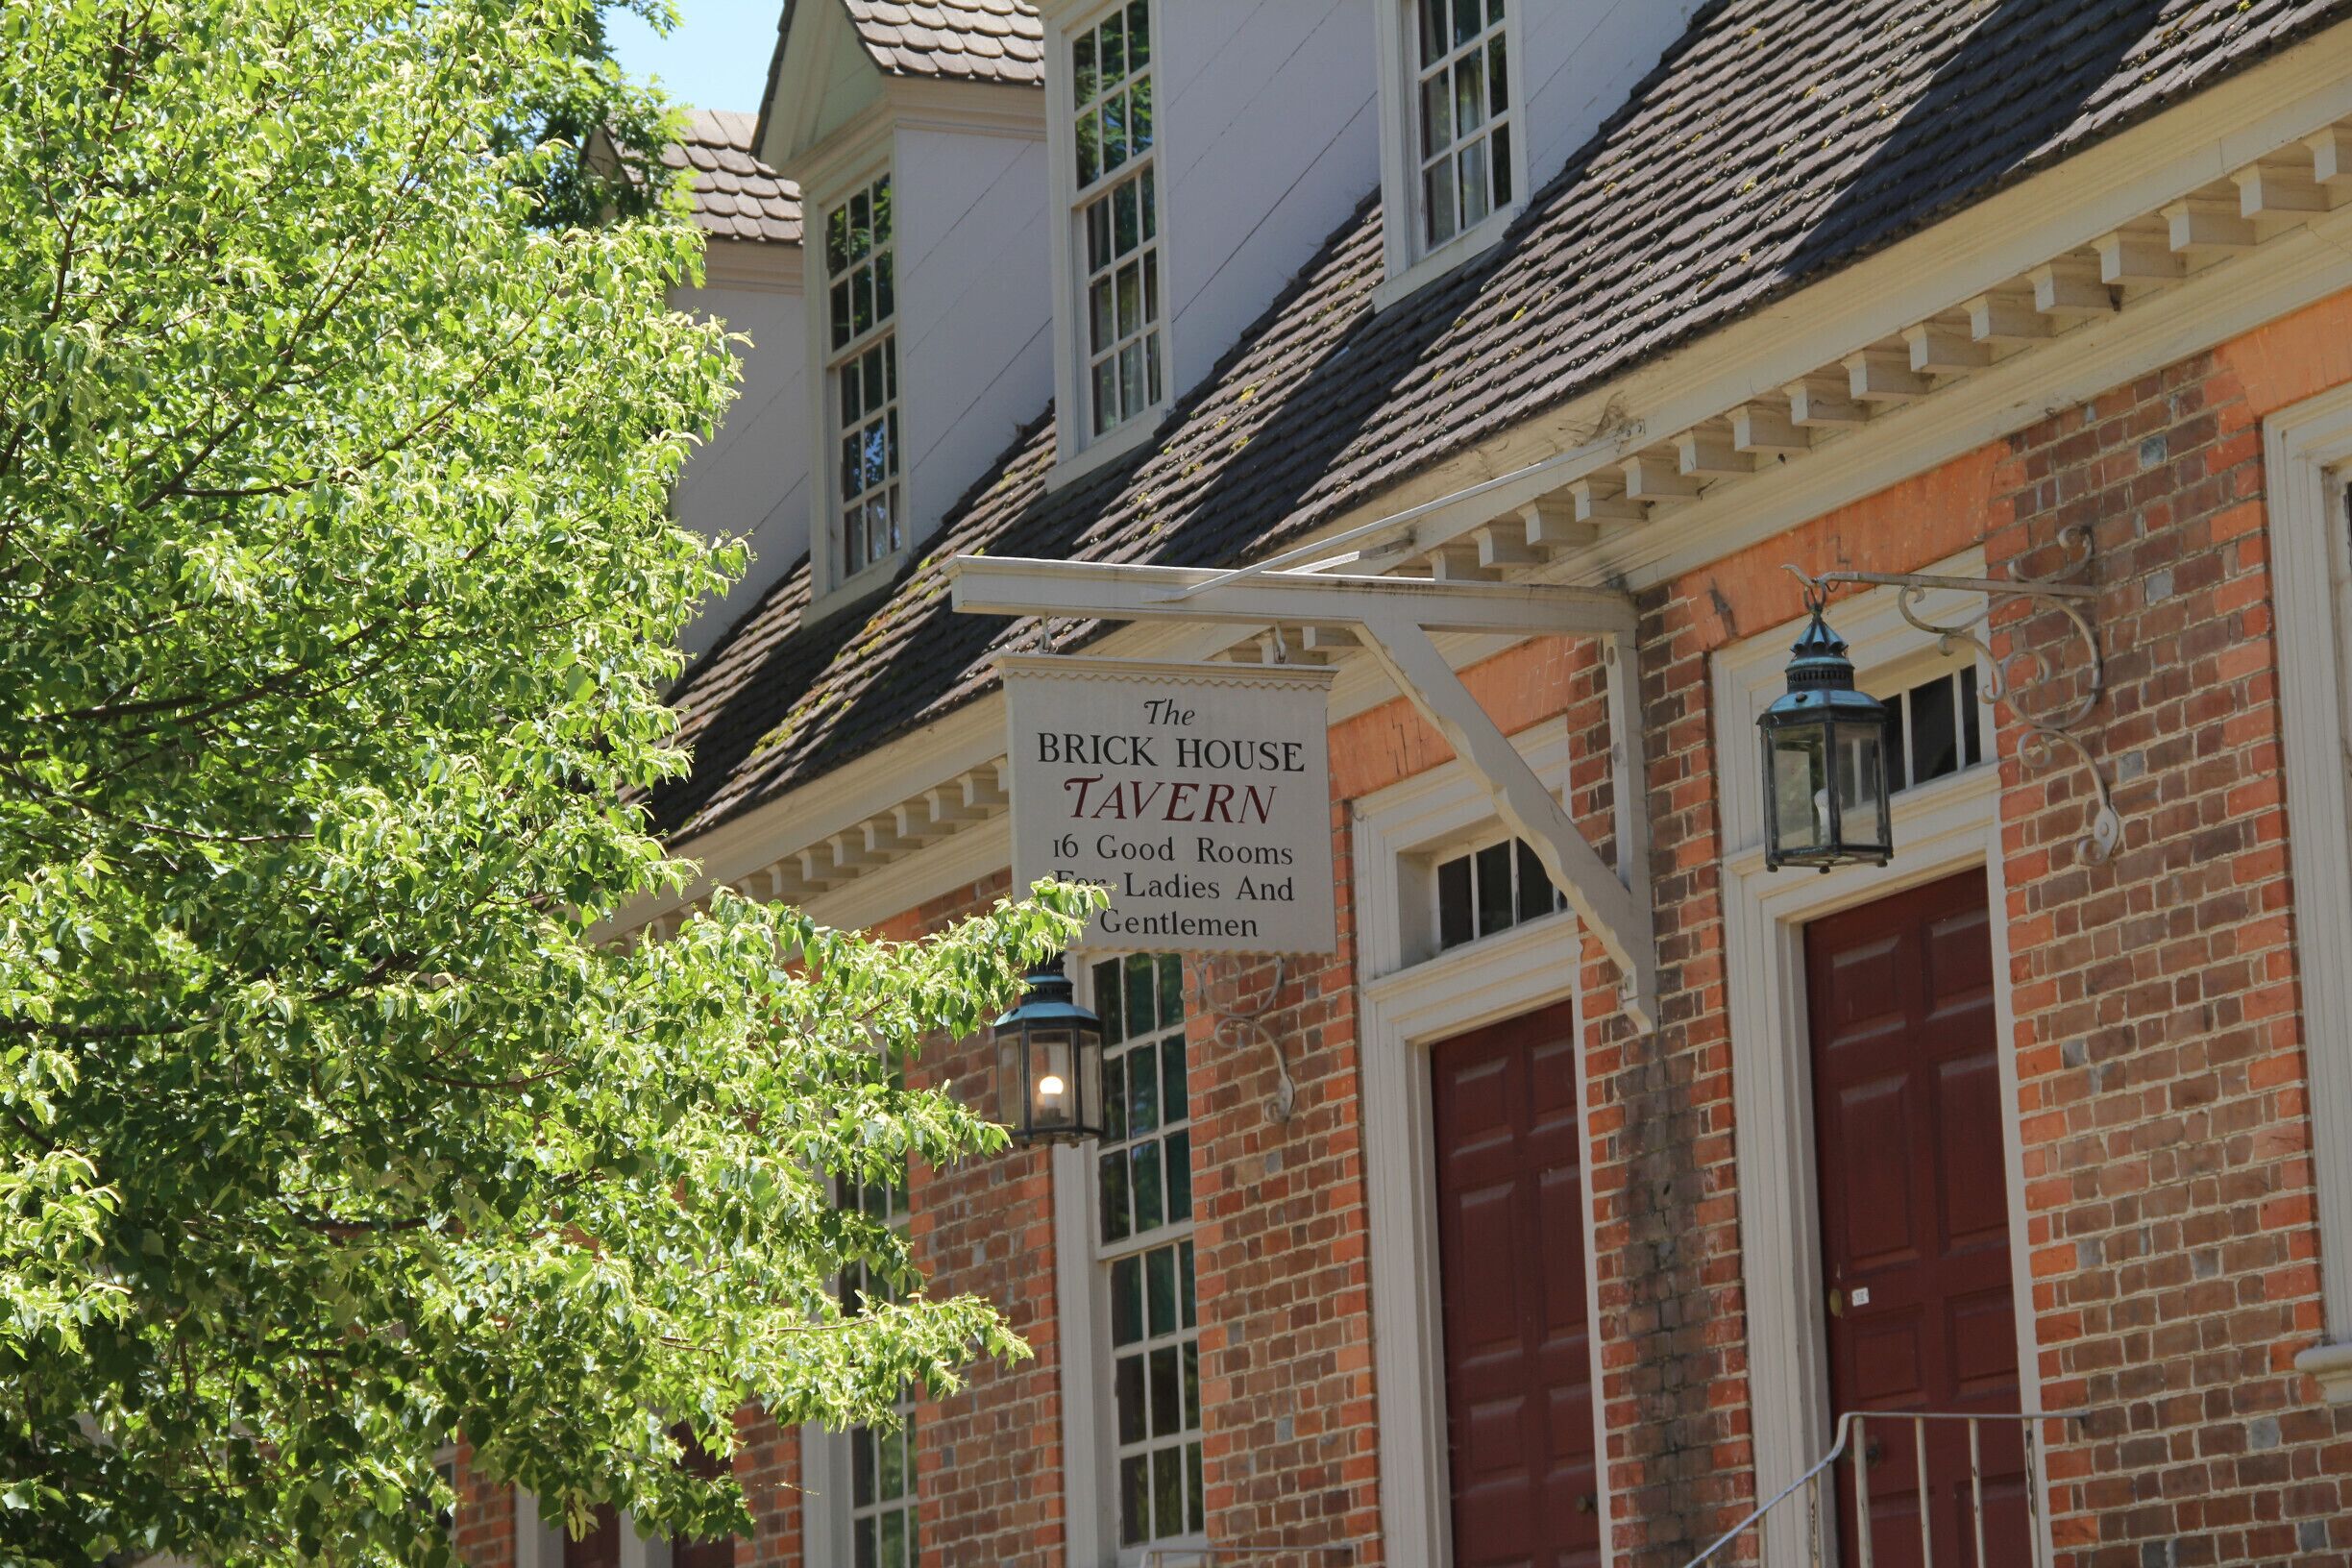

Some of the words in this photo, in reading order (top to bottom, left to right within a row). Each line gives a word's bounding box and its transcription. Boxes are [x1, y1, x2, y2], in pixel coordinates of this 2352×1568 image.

[1143, 698, 1195, 725] The
[1038, 732, 1158, 767] BRICK
[1176, 738, 1305, 772] HOUSE
[1064, 773, 1277, 824] TAVERN
[1053, 833, 1079, 858] 16
[1096, 834, 1175, 861] Good
[1196, 837, 1293, 865] Rooms
[1124, 872, 1220, 899] Ladies
[1236, 875, 1295, 901] And
[1100, 909, 1259, 938] Gentlemen
